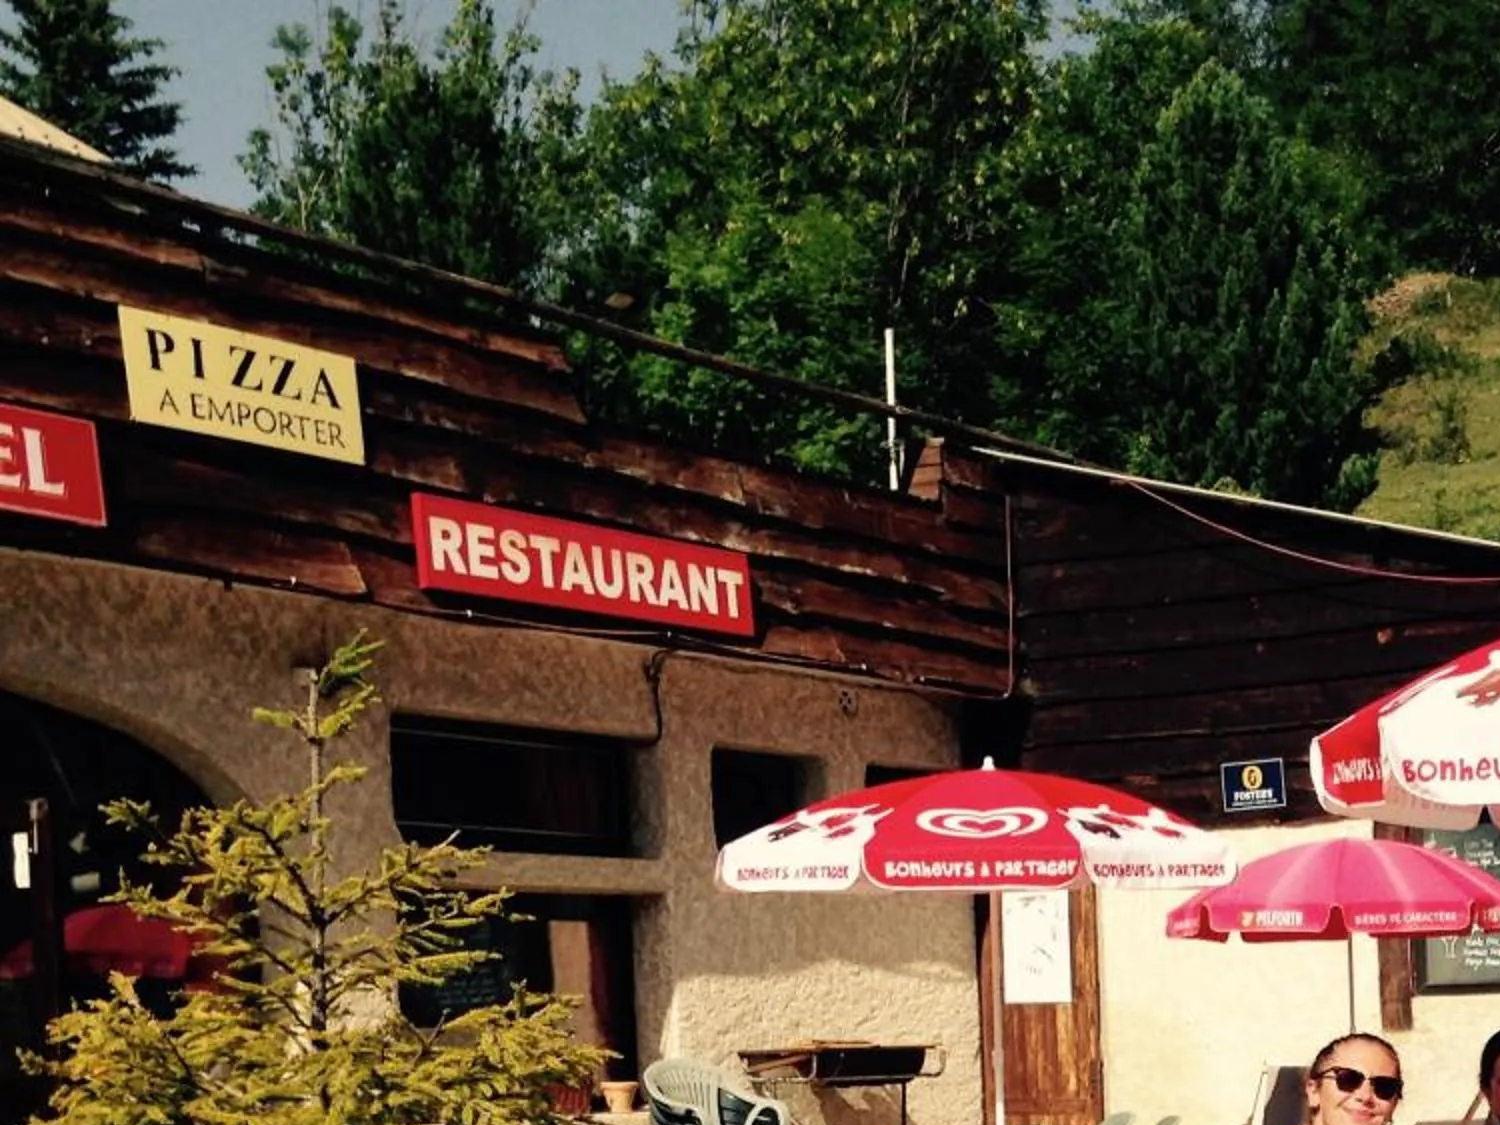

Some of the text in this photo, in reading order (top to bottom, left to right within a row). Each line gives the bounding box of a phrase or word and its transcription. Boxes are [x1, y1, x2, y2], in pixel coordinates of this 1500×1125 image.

[145, 327, 343, 410] PIZZA
[160, 388, 346, 449] A EMPORTER
[428, 516, 744, 619] RESTAURANT
